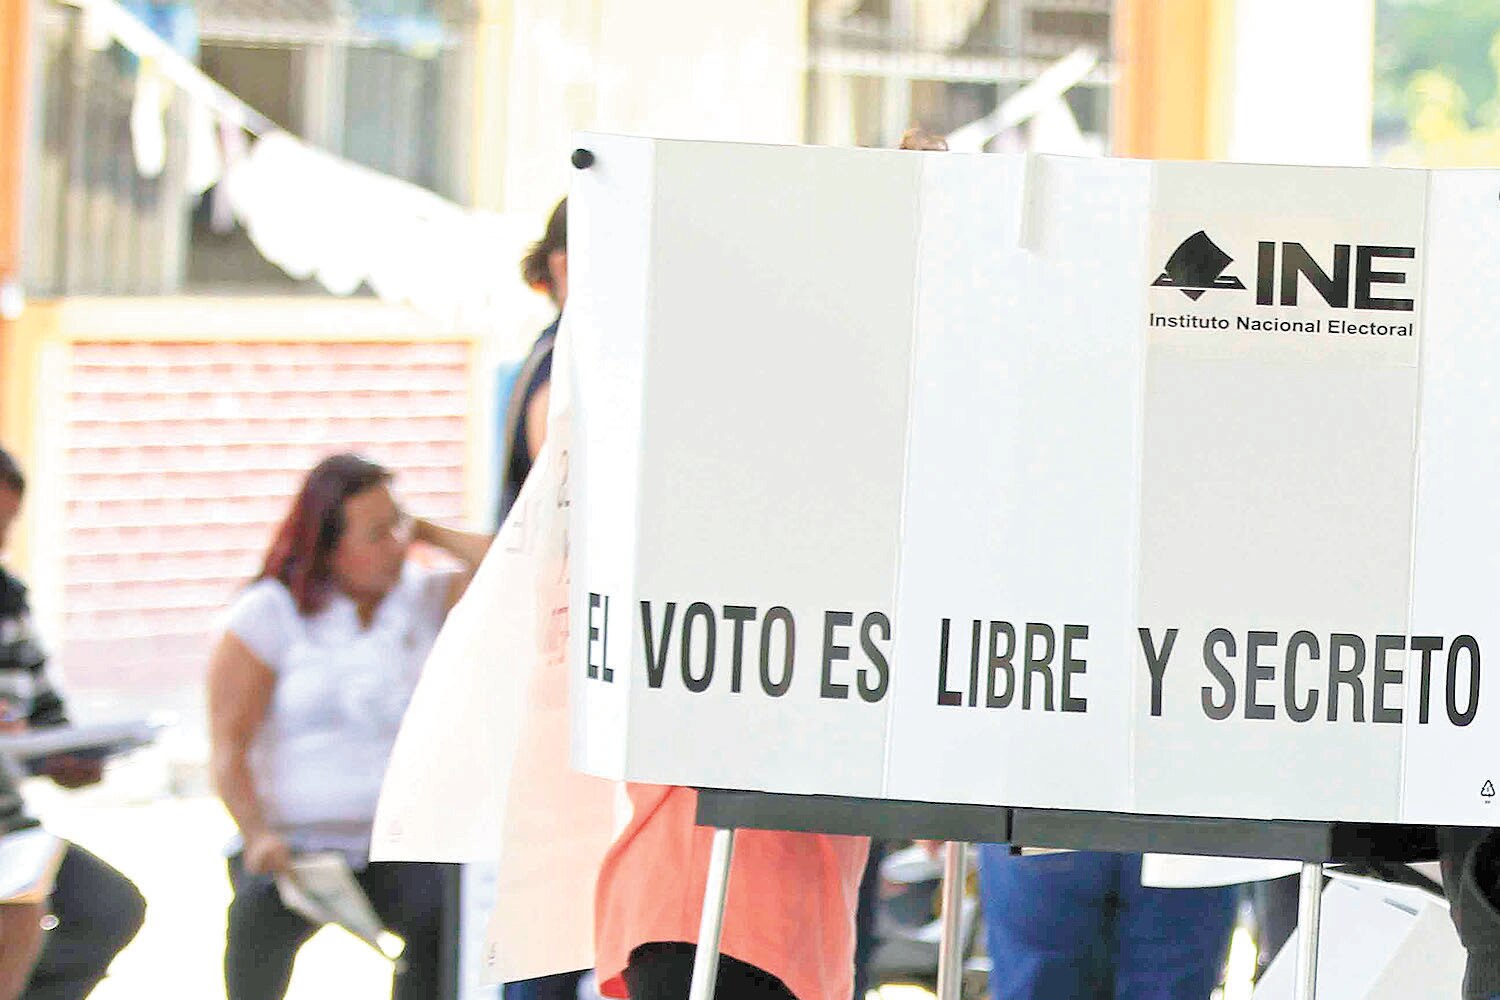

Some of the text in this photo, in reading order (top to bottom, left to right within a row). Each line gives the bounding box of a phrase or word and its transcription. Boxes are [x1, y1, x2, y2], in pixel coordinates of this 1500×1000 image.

[1256, 241, 1416, 312] INE
[1149, 313, 1413, 338] Instituto Nacional Electoral
[586, 592, 614, 683] EL
[640, 600, 796, 698] VOTO
[820, 610, 891, 703] ES
[937, 617, 1089, 713] LIBRE
[1138, 627, 1179, 717] Y
[1201, 627, 1481, 727] SECRETO
